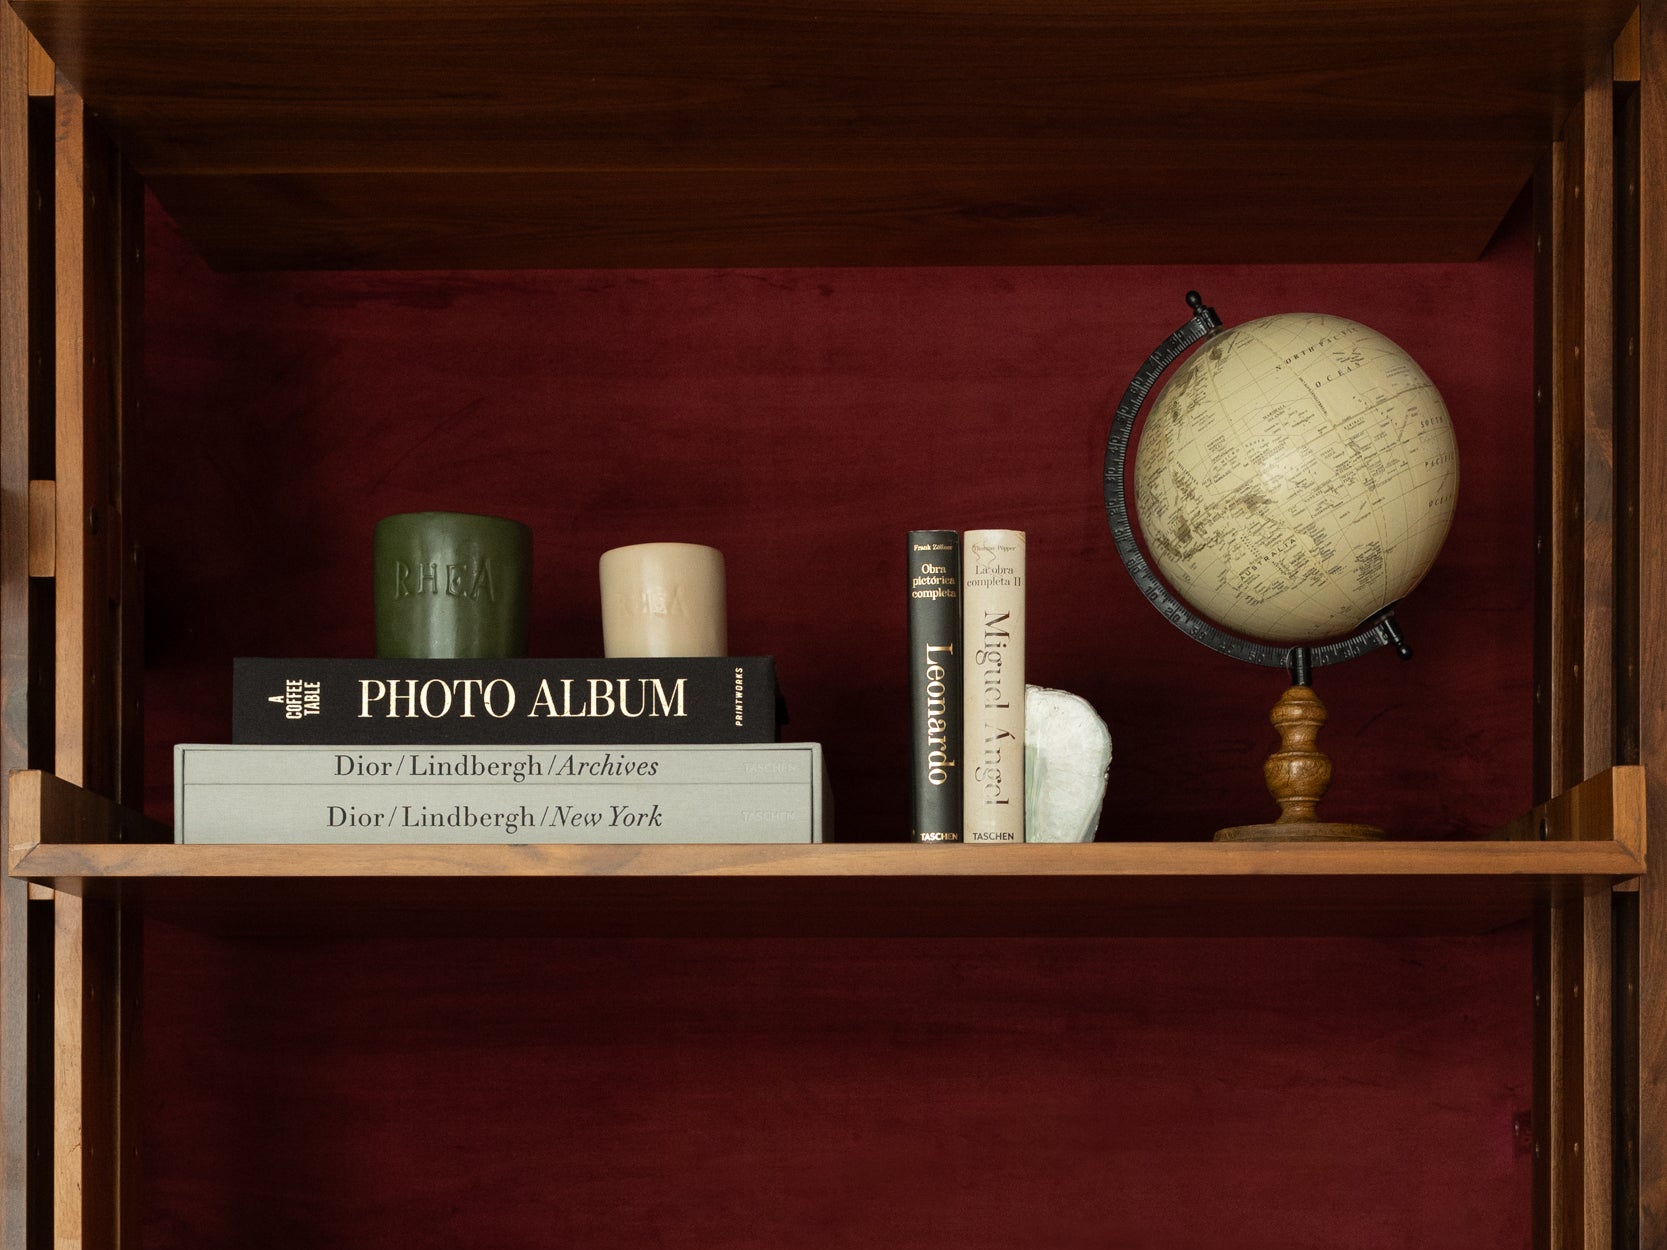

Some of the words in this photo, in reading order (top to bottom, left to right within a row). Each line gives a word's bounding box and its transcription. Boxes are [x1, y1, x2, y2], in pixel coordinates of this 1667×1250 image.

[913, 544, 932, 552] Frank
[1240, 538, 1296, 581] AUSTRALIA
[394, 558, 496, 601] RHEA
[921, 563, 947, 575] Obra
[975, 565, 989, 575] La
[991, 564, 1014, 575] obra
[911, 588, 957, 601] completa
[912, 576, 956, 589] pictórica
[966, 576, 1011, 589] completa
[1014, 576, 1021, 587] II
[975, 610, 1011, 709] Miguel
[268, 695, 285, 704] A
[285, 679, 303, 720] COFFEE
[303, 681, 321, 717] TABLE
[357, 678, 517, 719] PHOTO
[527, 678, 689, 718] ALBUM
[735, 667, 744, 727] PRINTWORKS
[925, 642, 957, 788] Leonardo
[975, 723, 1016, 806] Ángel
[608, 804, 664, 829] York
[919, 832, 958, 842] TASCHEN
[972, 832, 1015, 841] TASCHEN
